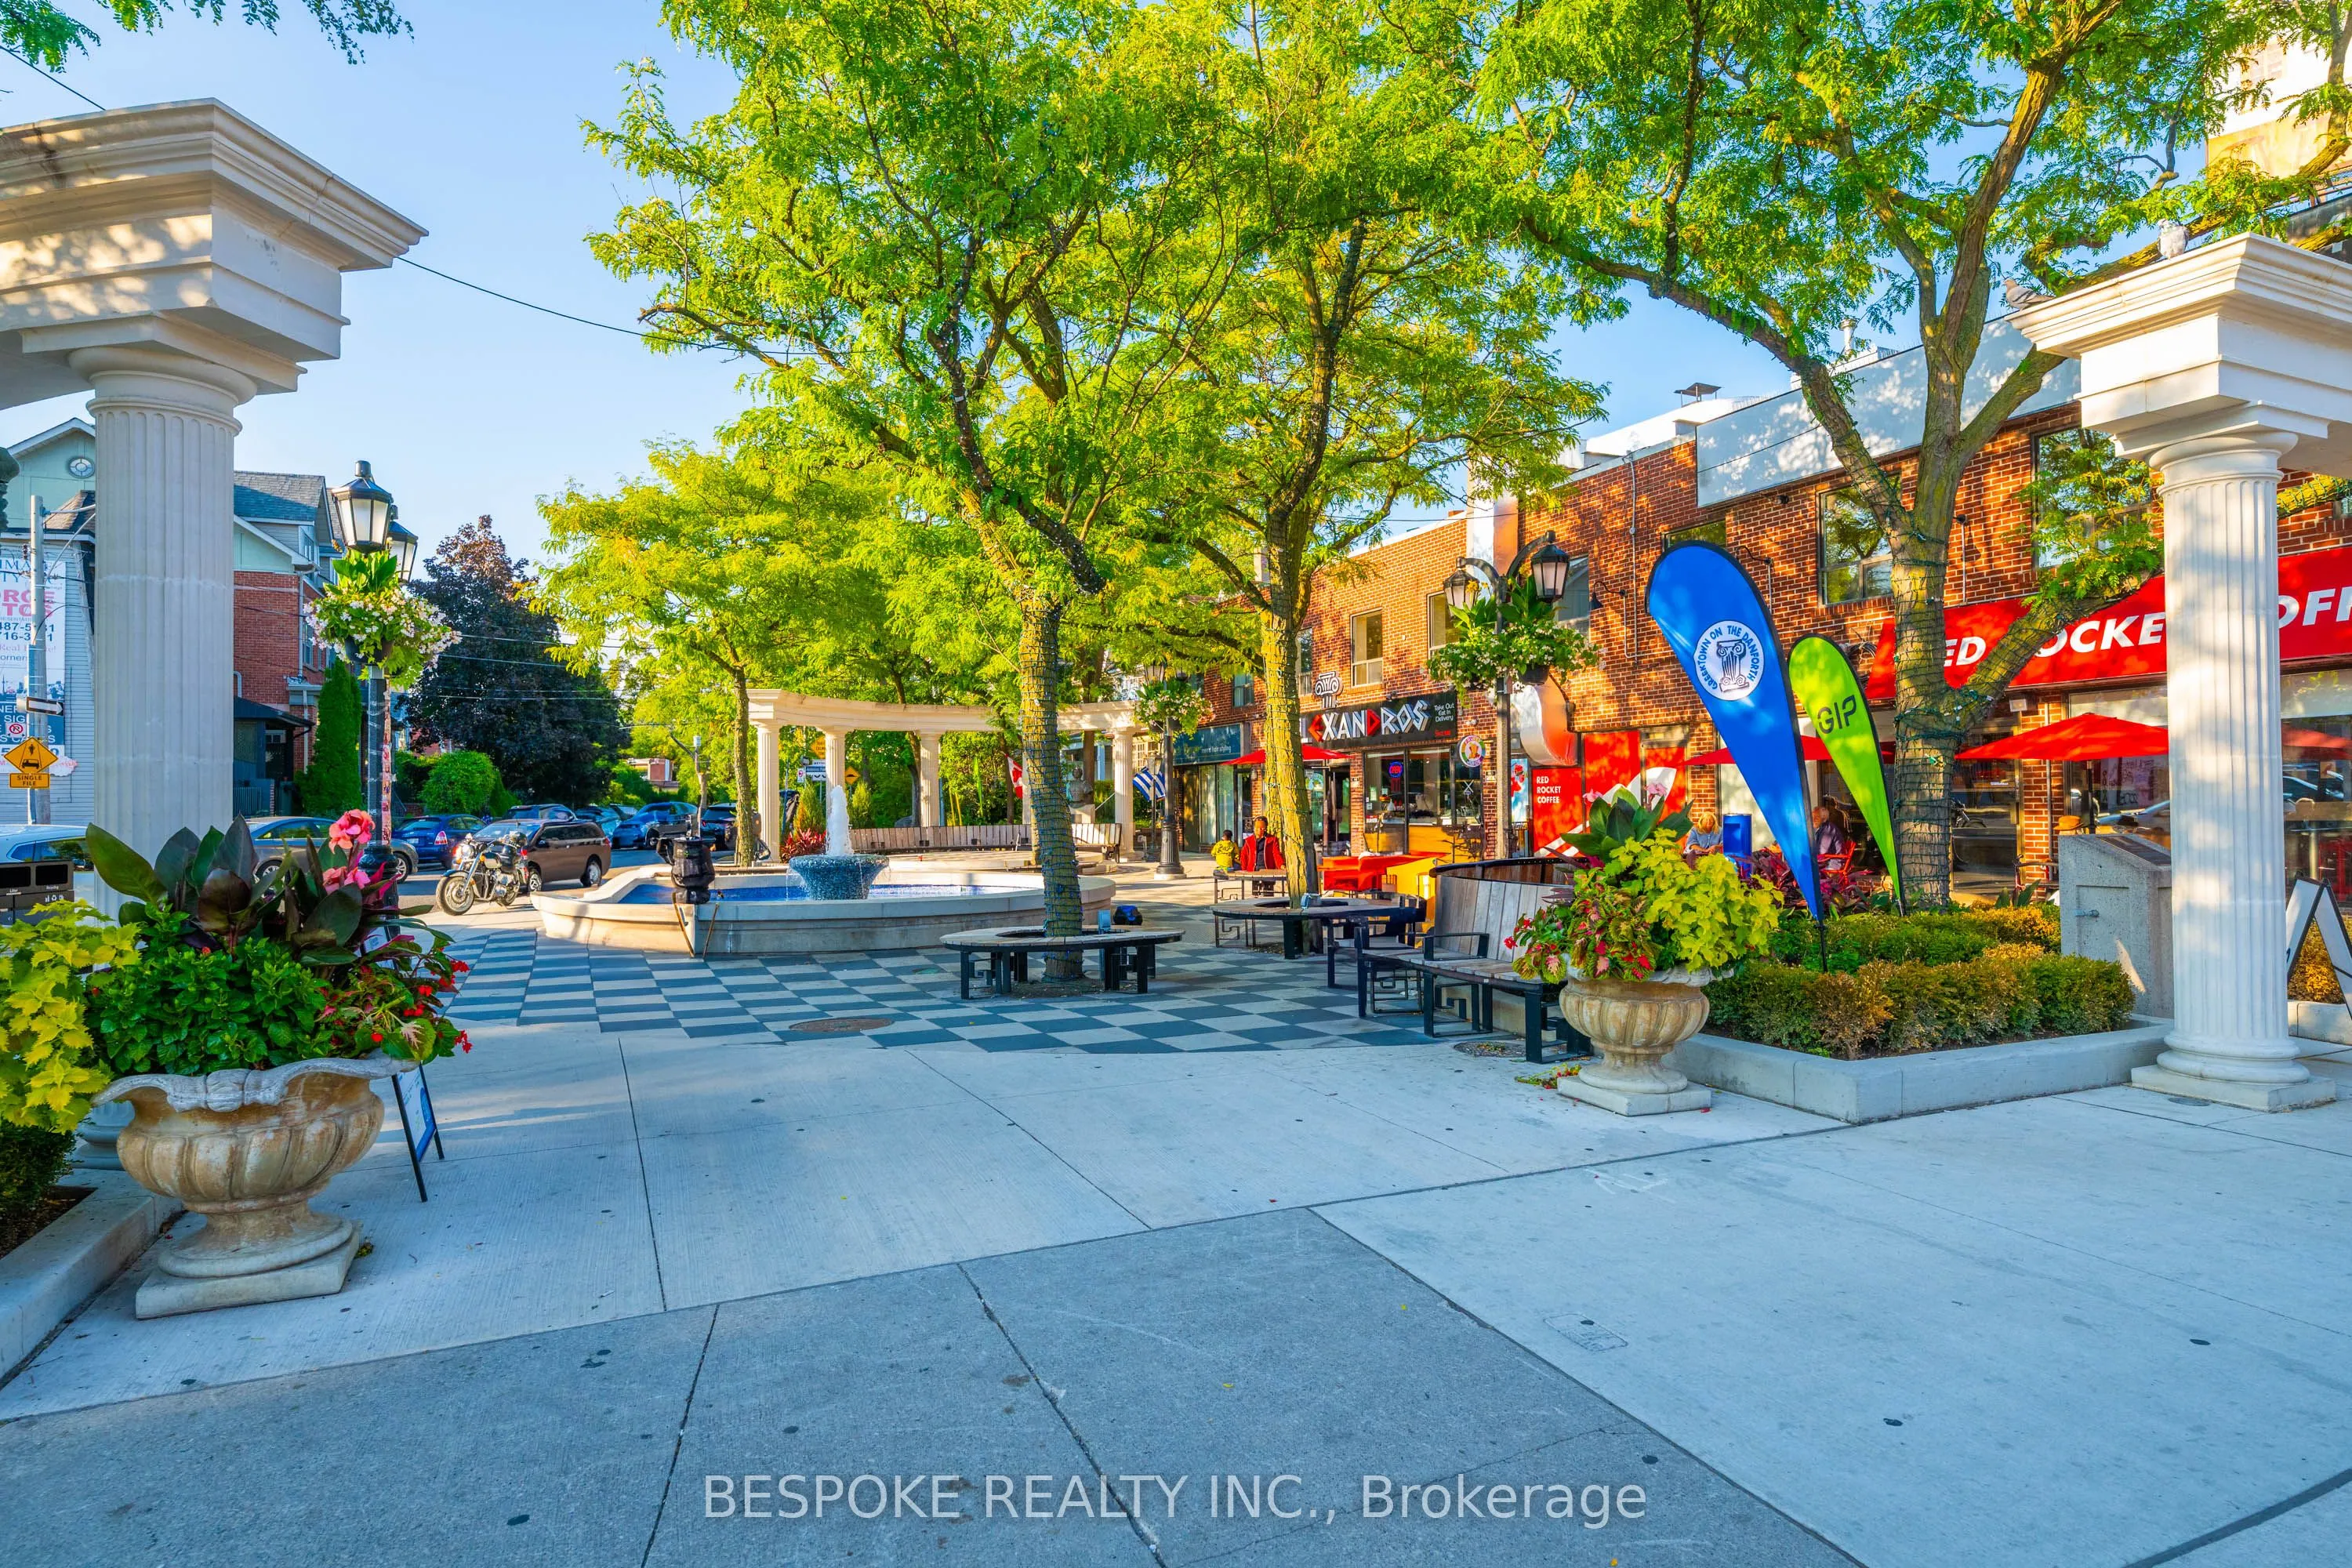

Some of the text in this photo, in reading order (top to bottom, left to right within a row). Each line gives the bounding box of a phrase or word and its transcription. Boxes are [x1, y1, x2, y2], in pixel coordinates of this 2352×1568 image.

[1944, 586, 2352, 666] ED OCKE OFF
[1697, 625, 1760, 690] GREEKTOWN ON THE DANFORTH
[1435, 714, 1454, 723] Delivery
[1817, 694, 1857, 735] GIP
[1536, 775, 1549, 784] RED
[1537, 786, 1562, 794] ROCKET
